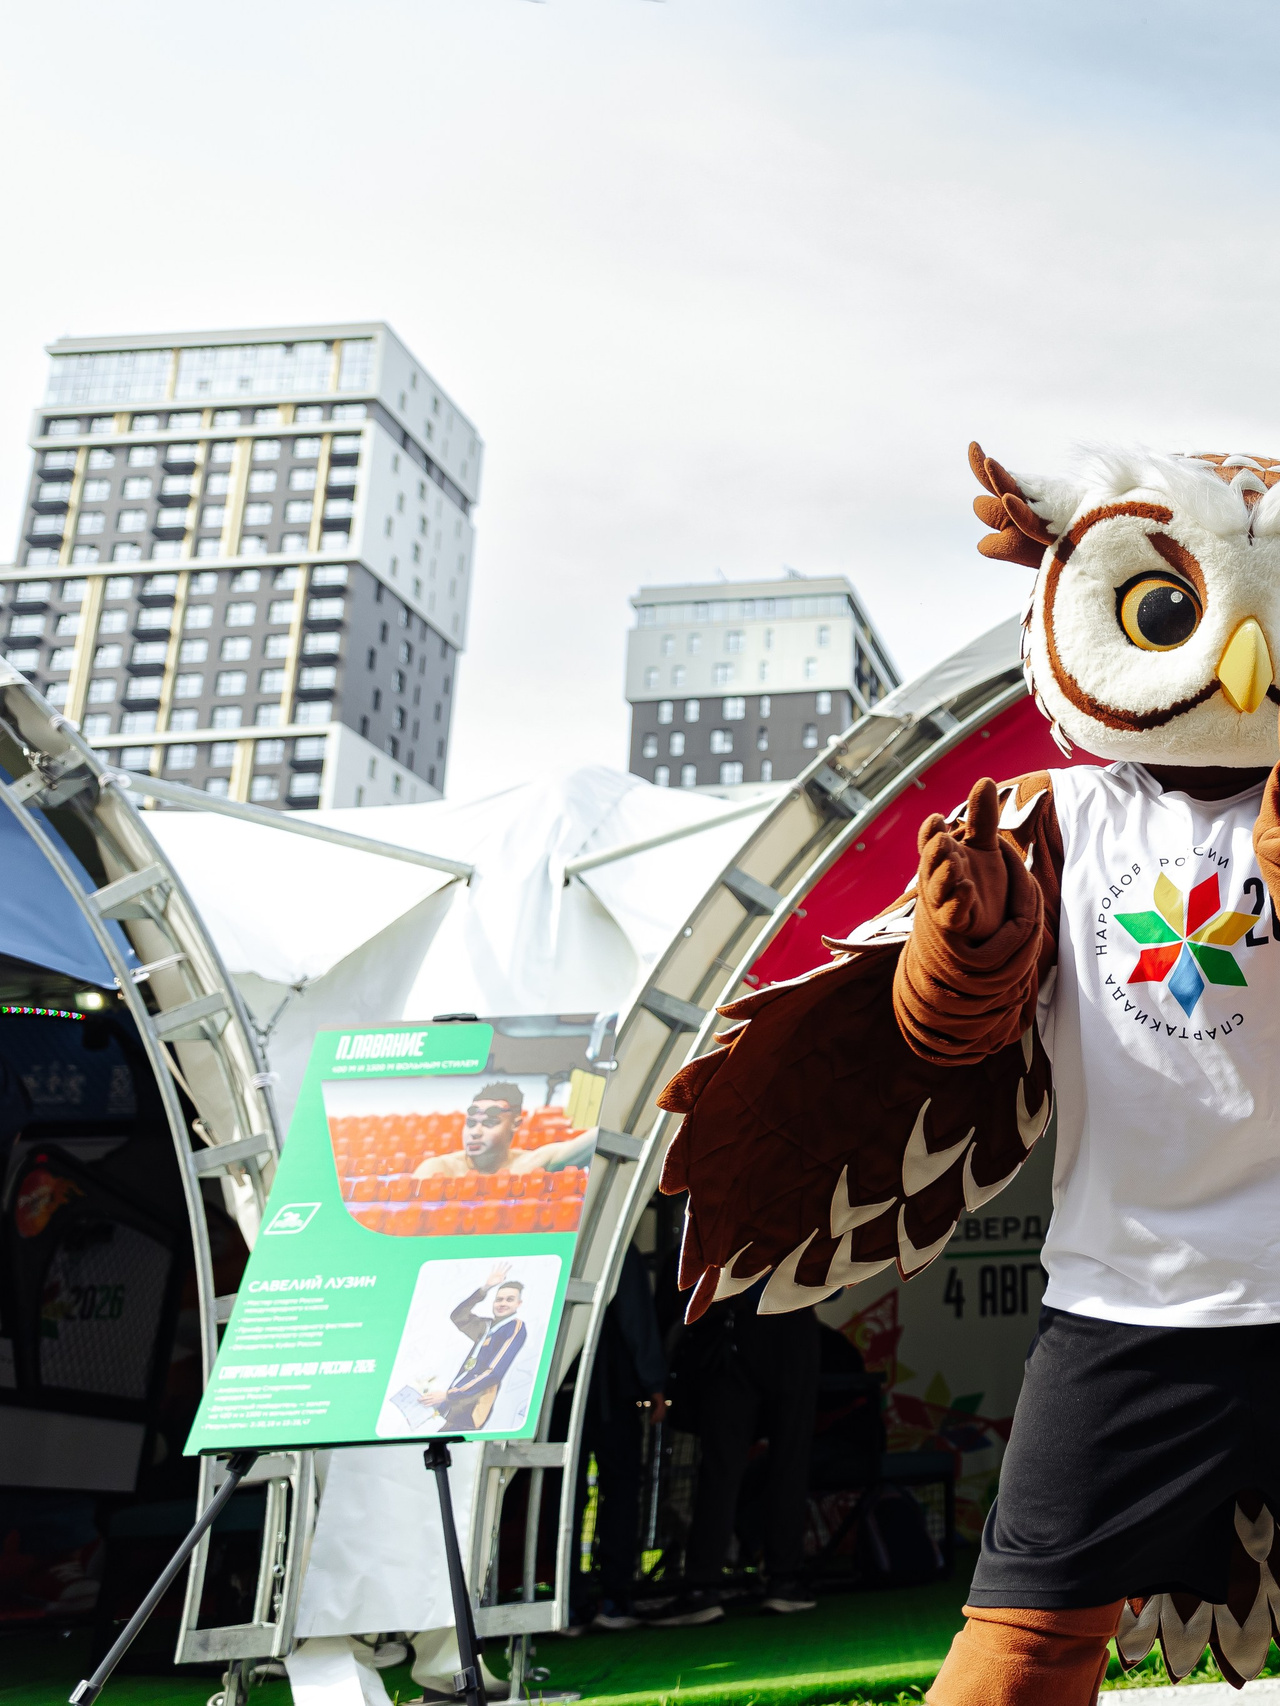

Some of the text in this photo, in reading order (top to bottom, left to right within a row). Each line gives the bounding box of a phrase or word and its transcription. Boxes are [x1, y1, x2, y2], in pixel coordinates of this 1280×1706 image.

[1096, 863, 1141, 955] НАРОДОВ
[1105, 974, 1244, 1040] СПАРТАКИАДА
[335, 1031, 428, 1060] ПЛАВАНИЕ
[950, 1215, 1044, 1242] ВЕРД
[248, 1275, 377, 1293] САВЕЛИЙ ЛУЗИН
[943, 1263, 1043, 1319] 4 АВГ
